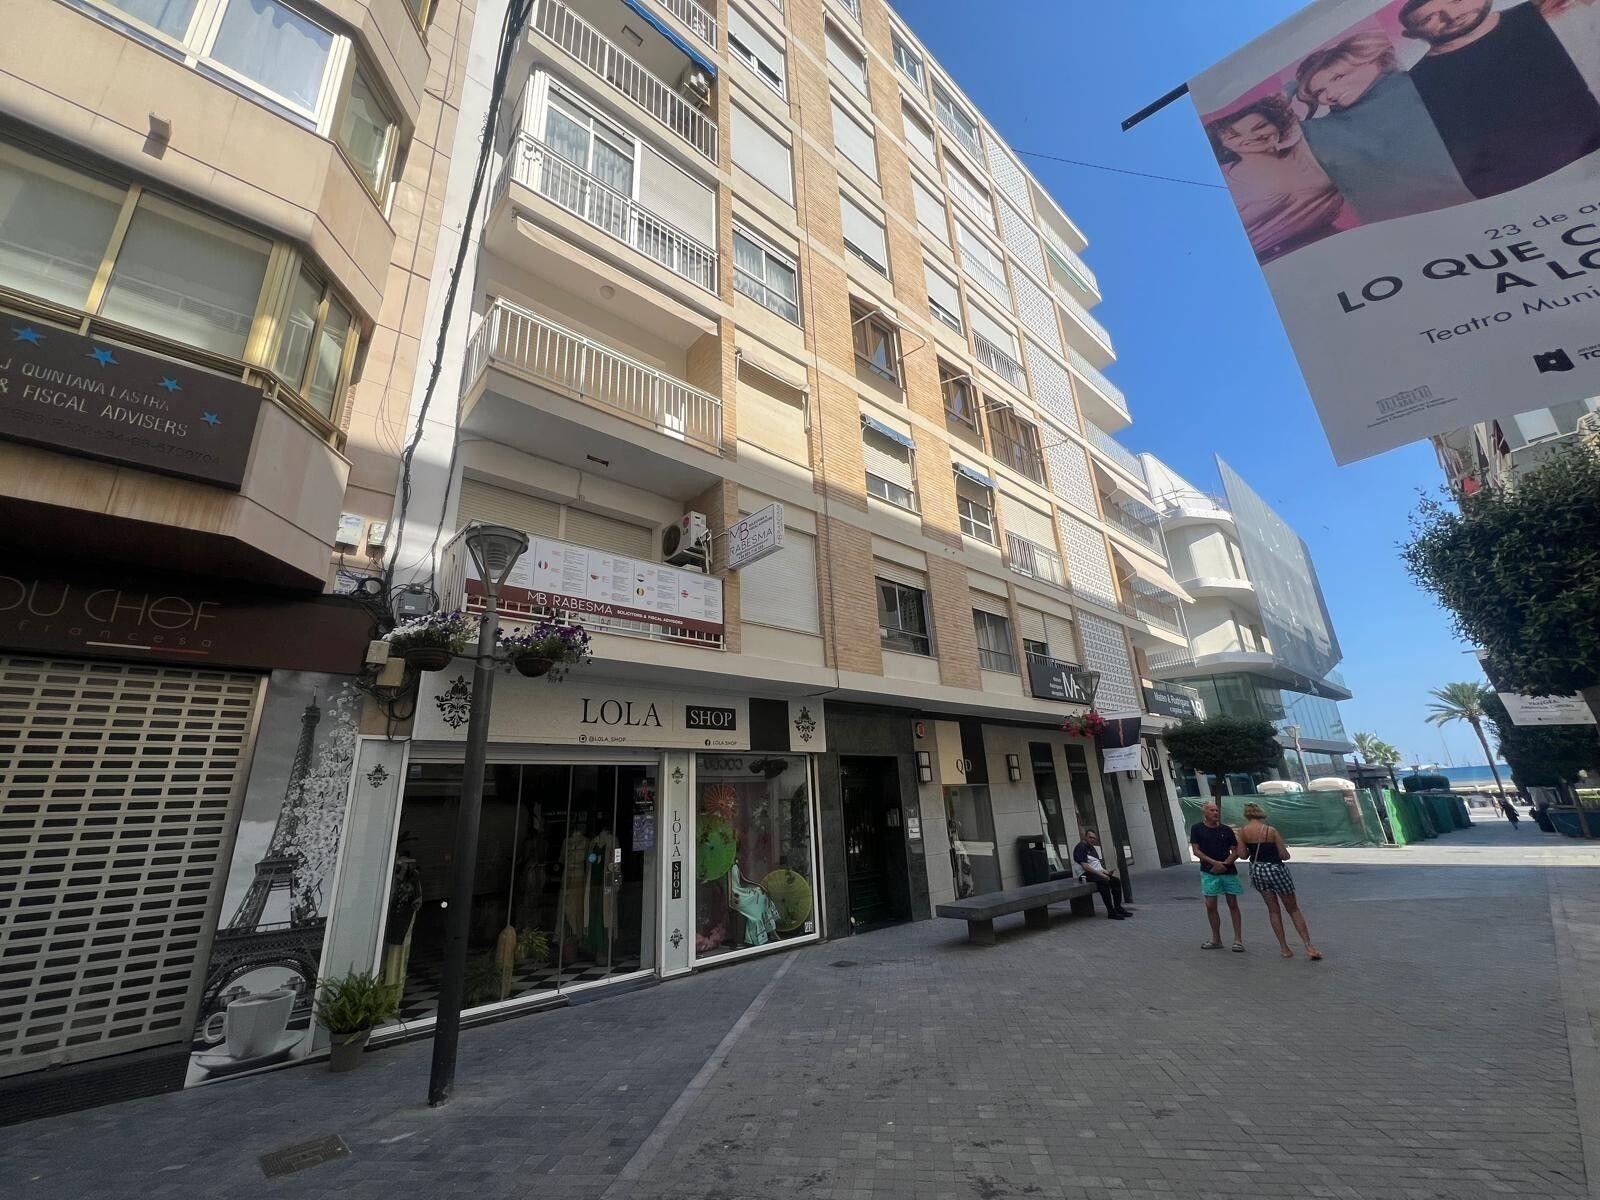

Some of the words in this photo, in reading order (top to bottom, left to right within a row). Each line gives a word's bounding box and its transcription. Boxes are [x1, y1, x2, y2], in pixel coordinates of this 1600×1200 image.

[1484, 223, 1521, 240] 23
[1532, 213, 1568, 228] de
[1578, 201, 1600, 214] a
[1337, 276, 1403, 313] LO
[1422, 240, 1545, 280] QUE
[1496, 271, 1539, 294] A
[1419, 311, 1513, 344] Teatro
[23, 384, 88, 413] FISCAL
[101, 404, 188, 437] ADVISERS
[730, 528, 773, 555] RABESMA
[527, 591, 548, 606] MB
[552, 595, 613, 615] RABESMA
[17, 619, 214, 648] francesa
[580, 698, 663, 728] LOLA
[690, 709, 732, 726] SHOP
[672, 810, 681, 858] LOLA
[672, 863, 680, 898] SHOP
